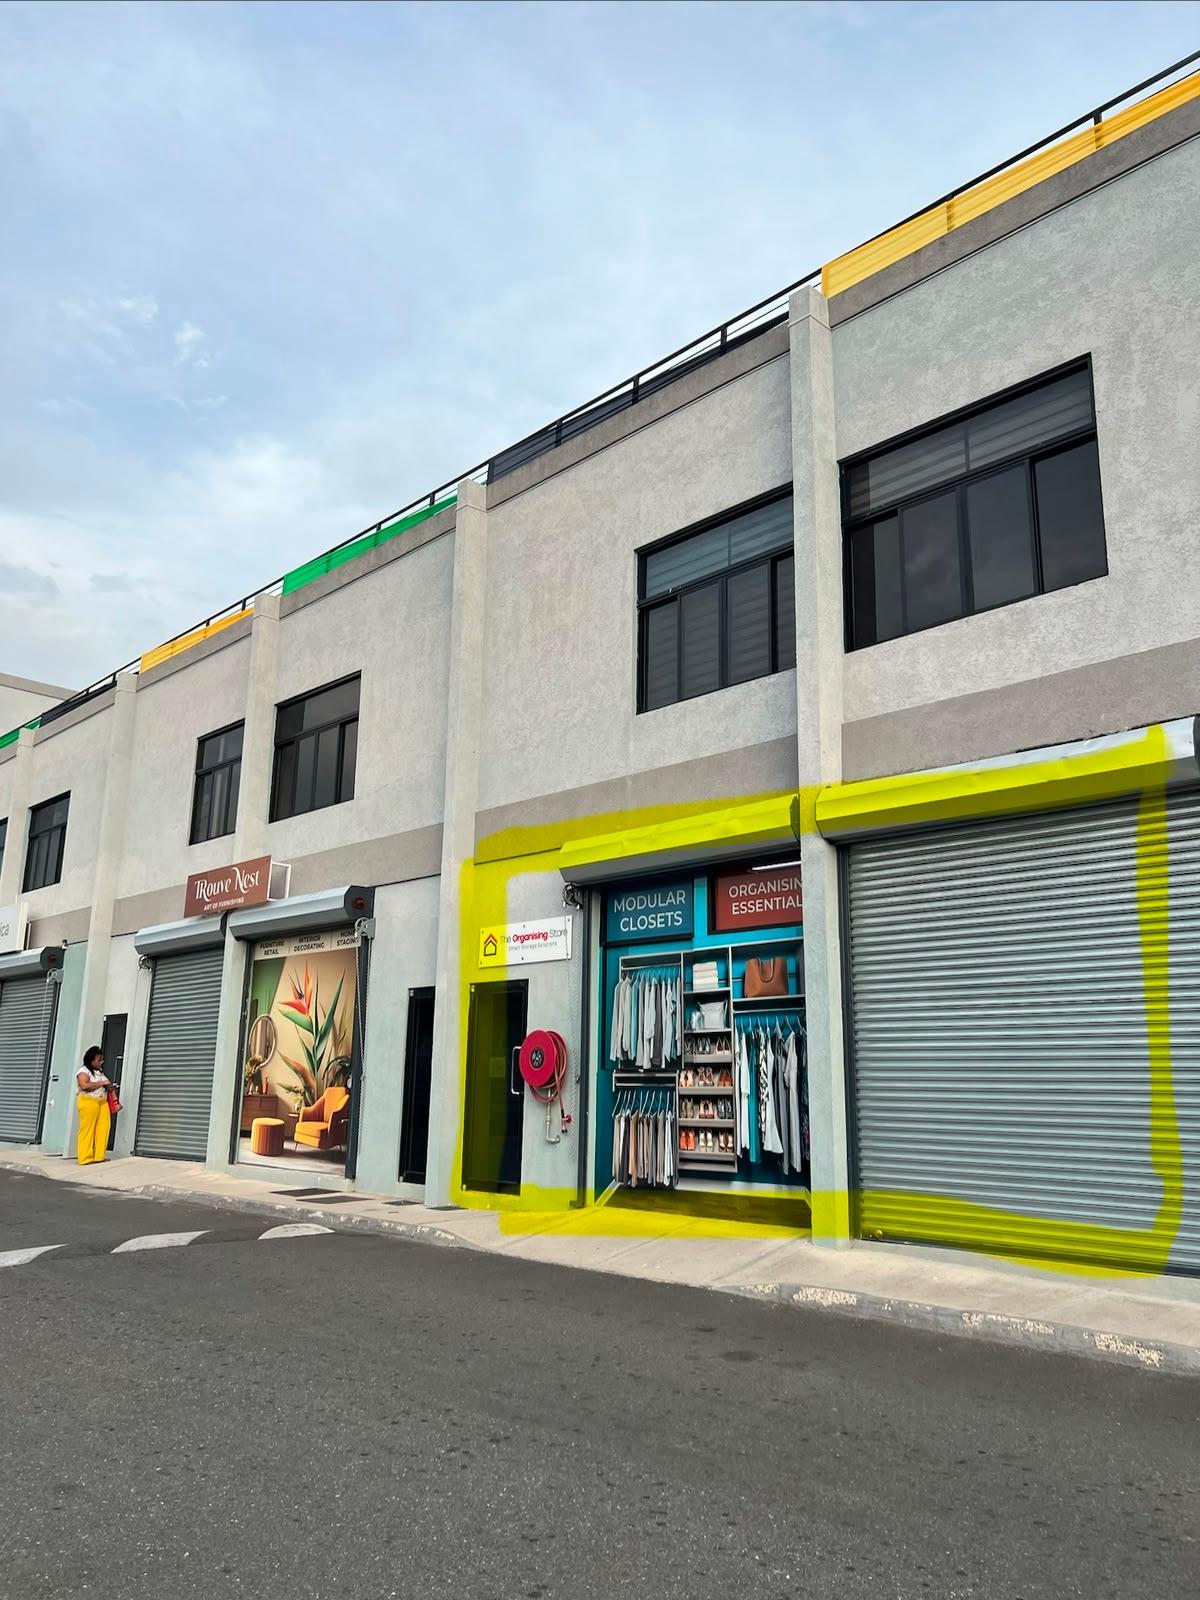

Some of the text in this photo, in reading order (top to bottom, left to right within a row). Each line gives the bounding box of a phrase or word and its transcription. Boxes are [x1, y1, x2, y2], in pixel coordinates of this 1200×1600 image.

[230, 867, 260, 894] Nest
[203, 903, 212, 911] ART
[614, 890, 686, 914] MODULAR
[619, 910, 683, 933] CLOSETS
[298, 934, 321, 943] INTERIOR
[512, 931, 548, 944] Organising
[549, 929, 568, 938] Store
[263, 948, 279, 956] RETAIL
[293, 942, 325, 952] DECORATING
